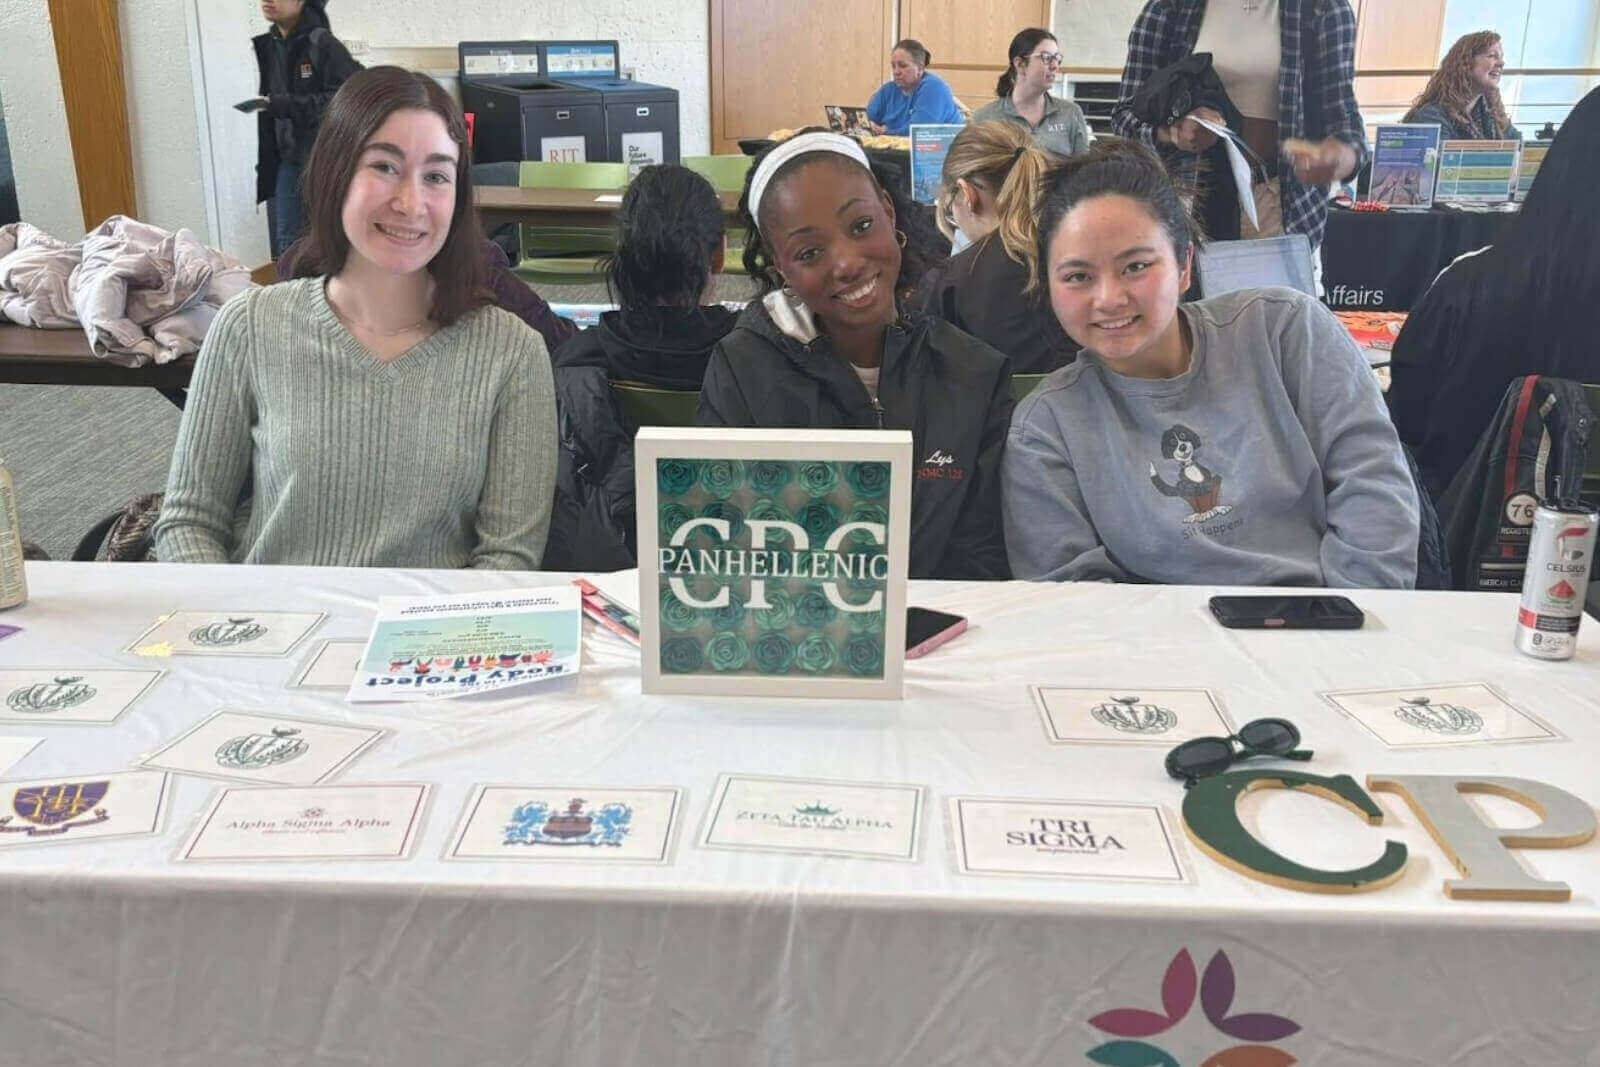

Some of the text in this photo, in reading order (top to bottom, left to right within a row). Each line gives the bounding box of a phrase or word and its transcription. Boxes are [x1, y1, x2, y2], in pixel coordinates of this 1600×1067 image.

[549, 149, 579, 163] RIT
[1511, 503, 1535, 519] 76
[657, 547, 889, 581] PANHELLENIC
[669, 517, 886, 613] CPC
[366, 674, 478, 688] Project
[226, 818, 276, 831] Alpha
[282, 817, 334, 830] Sigma
[340, 815, 392, 828] Alpha
[1030, 818, 1092, 833] TRI
[1006, 832, 1127, 850] SIGMA
